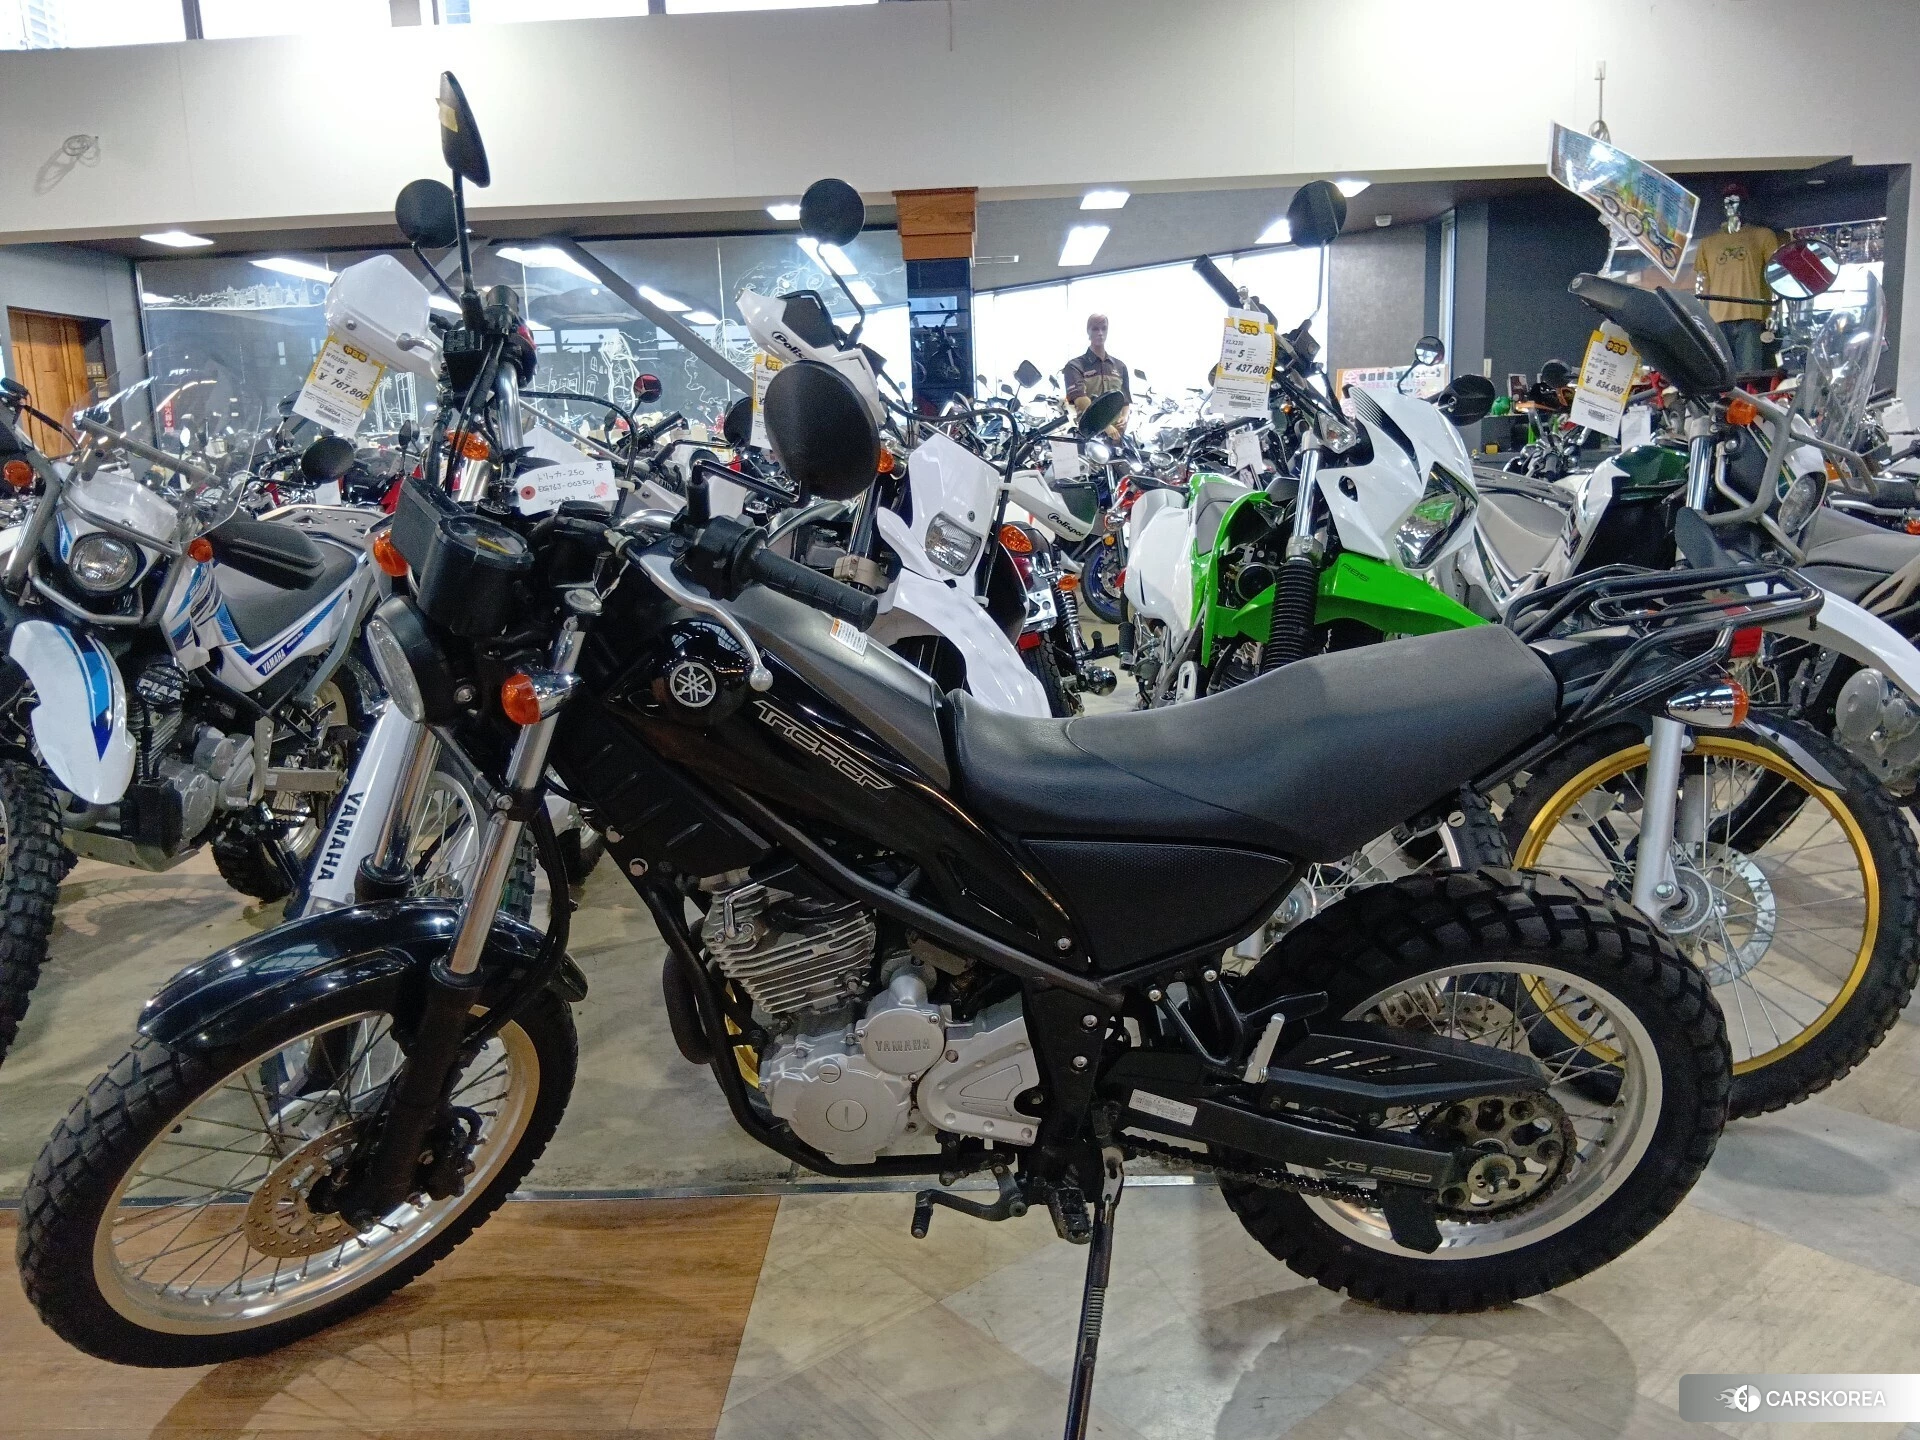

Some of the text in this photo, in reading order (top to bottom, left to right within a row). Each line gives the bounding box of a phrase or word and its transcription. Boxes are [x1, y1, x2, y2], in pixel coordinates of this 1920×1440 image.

[1238, 350, 1245, 358] 5
[336, 367, 345, 375] 6
[1236, 364, 1268, 375] 437,800
[331, 379, 368, 401] 767,800
[1596, 379, 1624, 395] 834,900
[262, 649, 286, 675] YAMAHA
[138, 679, 181, 700] PIAA
[317, 792, 364, 880] YAMAHA
[875, 1038, 930, 1051] YAMAHA
[1324, 1157, 1433, 1183] XG 250
